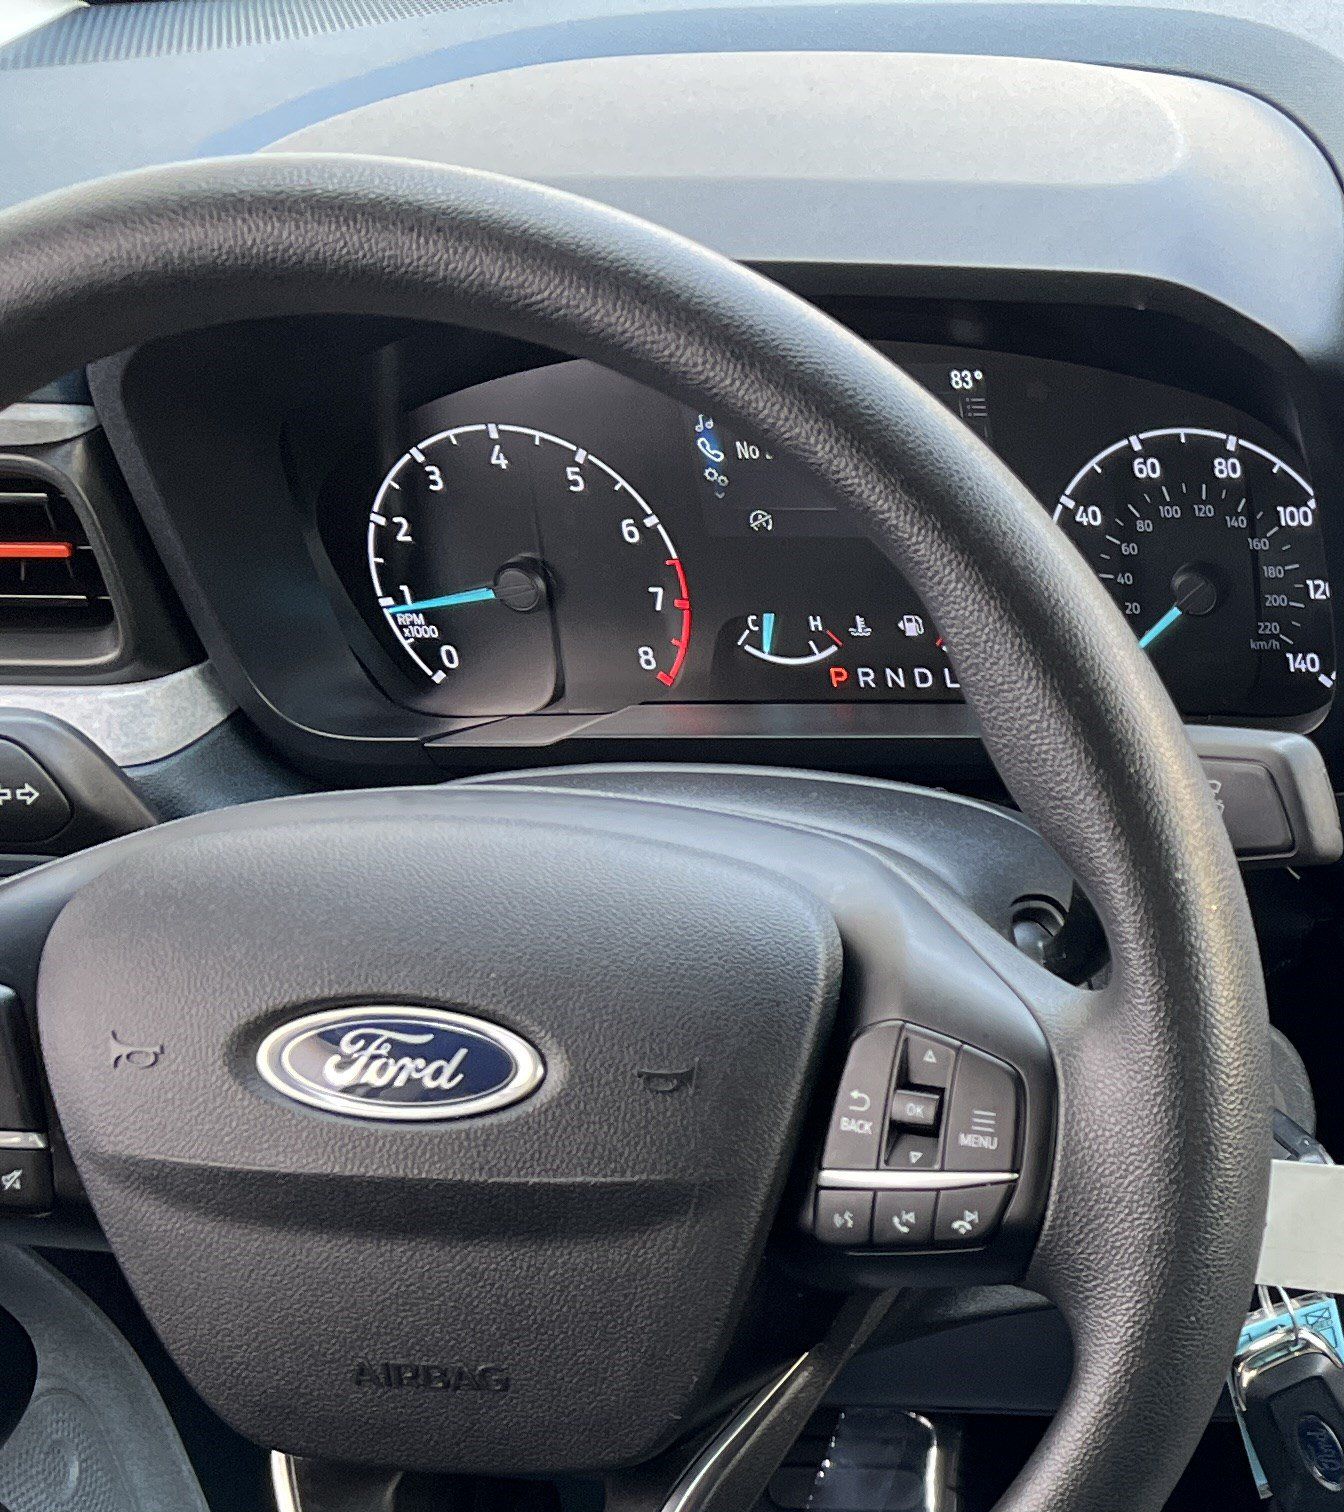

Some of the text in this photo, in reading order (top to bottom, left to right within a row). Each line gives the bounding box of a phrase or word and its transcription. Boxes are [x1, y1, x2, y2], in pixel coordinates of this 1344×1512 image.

[490, 447, 509, 470] 4
[1133, 457, 1161, 479] 60
[1213, 458, 1241, 478] 80
[427, 467, 444, 491] 3
[567, 468, 585, 492] 5
[1075, 506, 1102, 526] 40
[1159, 505, 1181, 518] 100
[1193, 505, 1215, 517] 120
[1277, 506, 1313, 527] 100
[395, 518, 413, 542] 2
[620, 519, 641, 544] 6
[1136, 520, 1153, 532] 80
[1225, 516, 1247, 528] 140
[1121, 543, 1138, 555] 60
[1248, 538, 1269, 550] 160
[1117, 573, 1133, 585] 40
[1263, 566, 1285, 578] 180
[648, 587, 665, 610] 7
[1124, 602, 1141, 614] 20
[1265, 595, 1287, 607] 200
[397, 613, 425, 627] RPM
[747, 616, 758, 632] C
[808, 616, 822, 631] H
[1257, 622, 1280, 634] 220
[1250, 638, 1280, 651] km/h
[440, 646, 460, 670] 0
[638, 646, 656, 670] 8
[1286, 653, 1320, 673] 140
[830, 668, 961, 689] P R N D L
[323, 1027, 468, 1095] Ford
[906, 1103, 924, 1117] OK
[840, 1117, 872, 1136] BACK
[959, 1132, 998, 1151] MENU
[353, 1359, 510, 1393] AIRBAG
